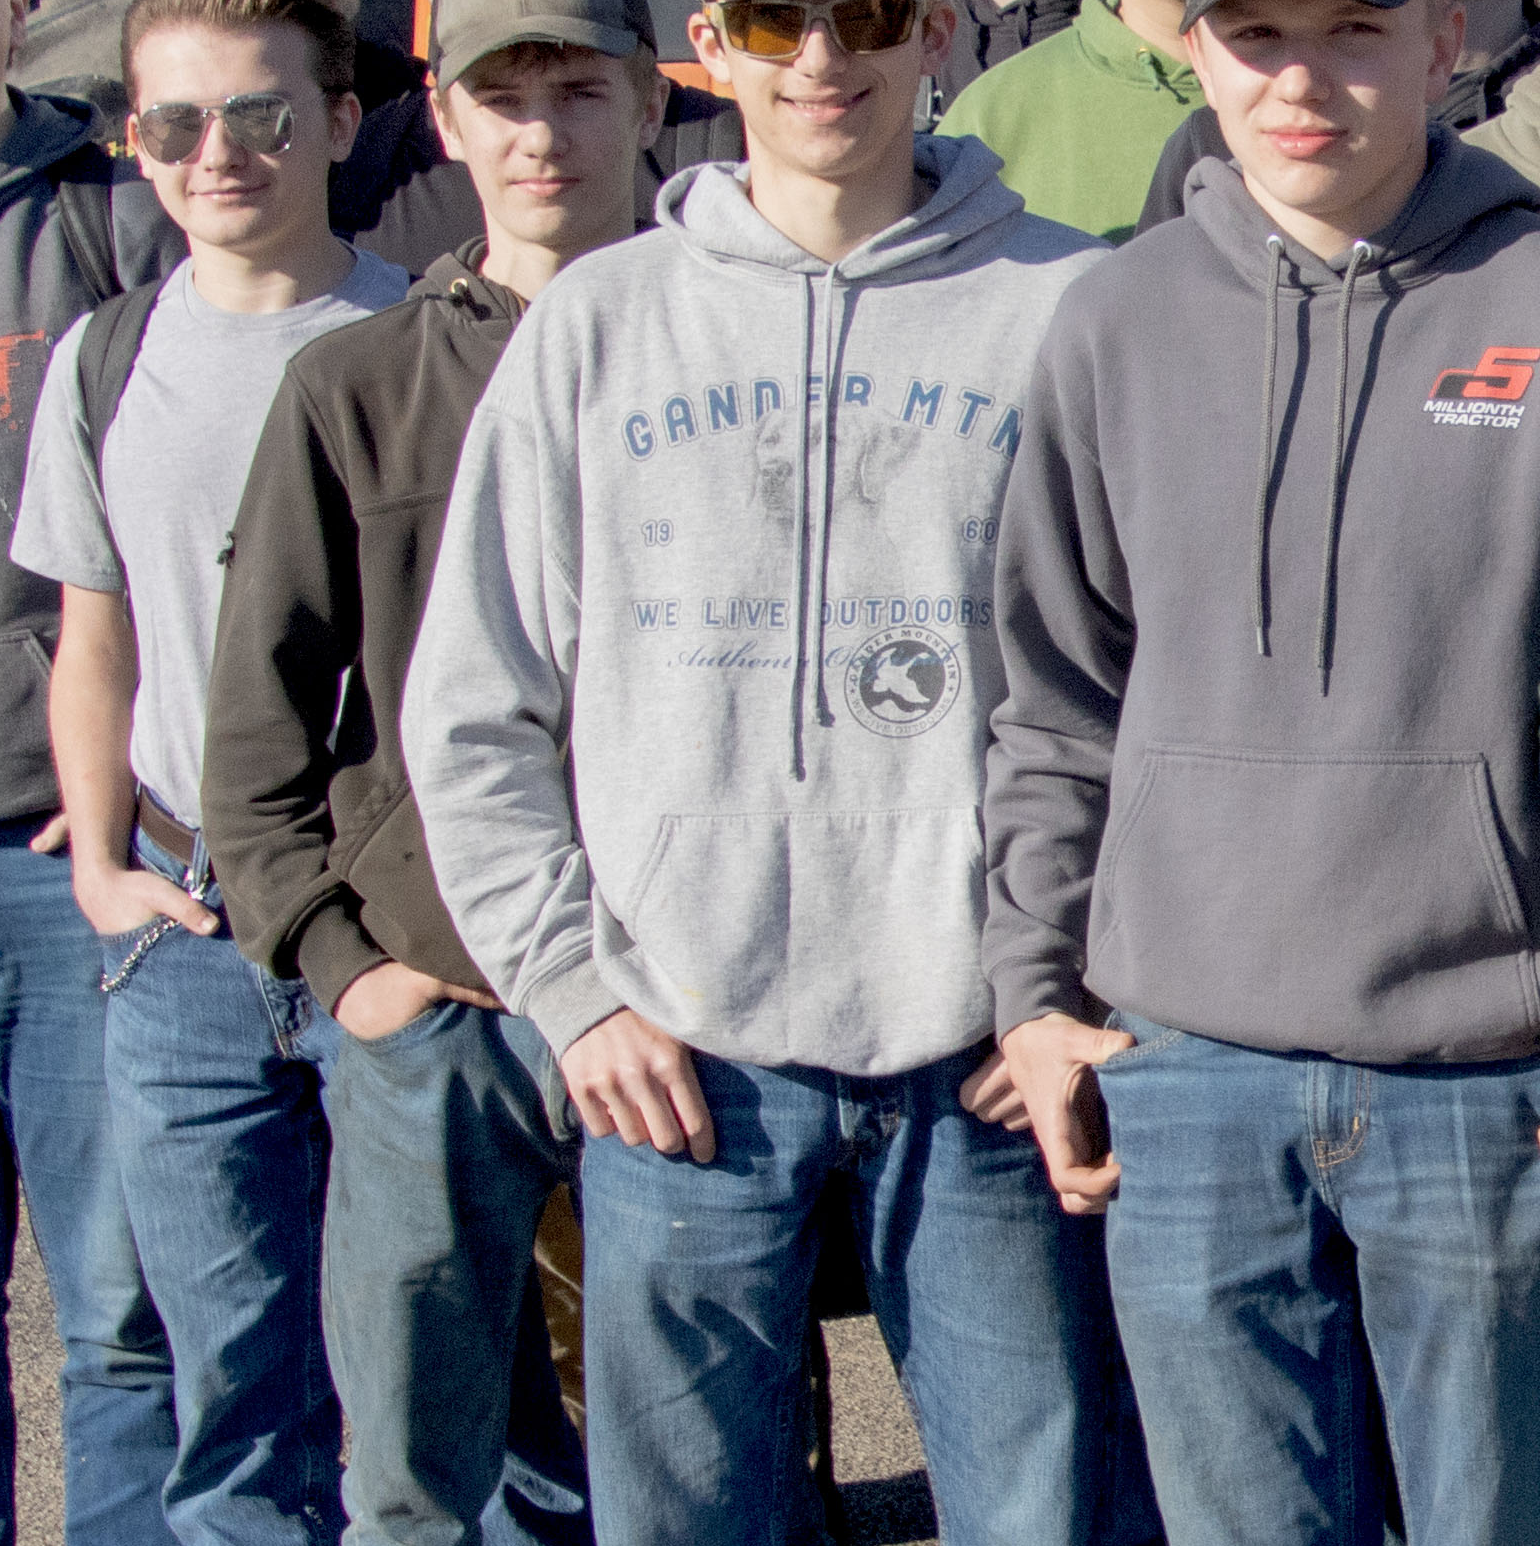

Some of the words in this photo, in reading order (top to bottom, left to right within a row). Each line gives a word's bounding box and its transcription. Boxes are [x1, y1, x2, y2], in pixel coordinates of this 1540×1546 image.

[1423, 400, 1526, 417] MILLIONTH
[1433, 412, 1521, 430] TRACTOR
[643, 519, 674, 546] 19
[964, 517, 999, 544] 60
[634, 600, 681, 630] WE
[703, 598, 790, 629] LIVE
